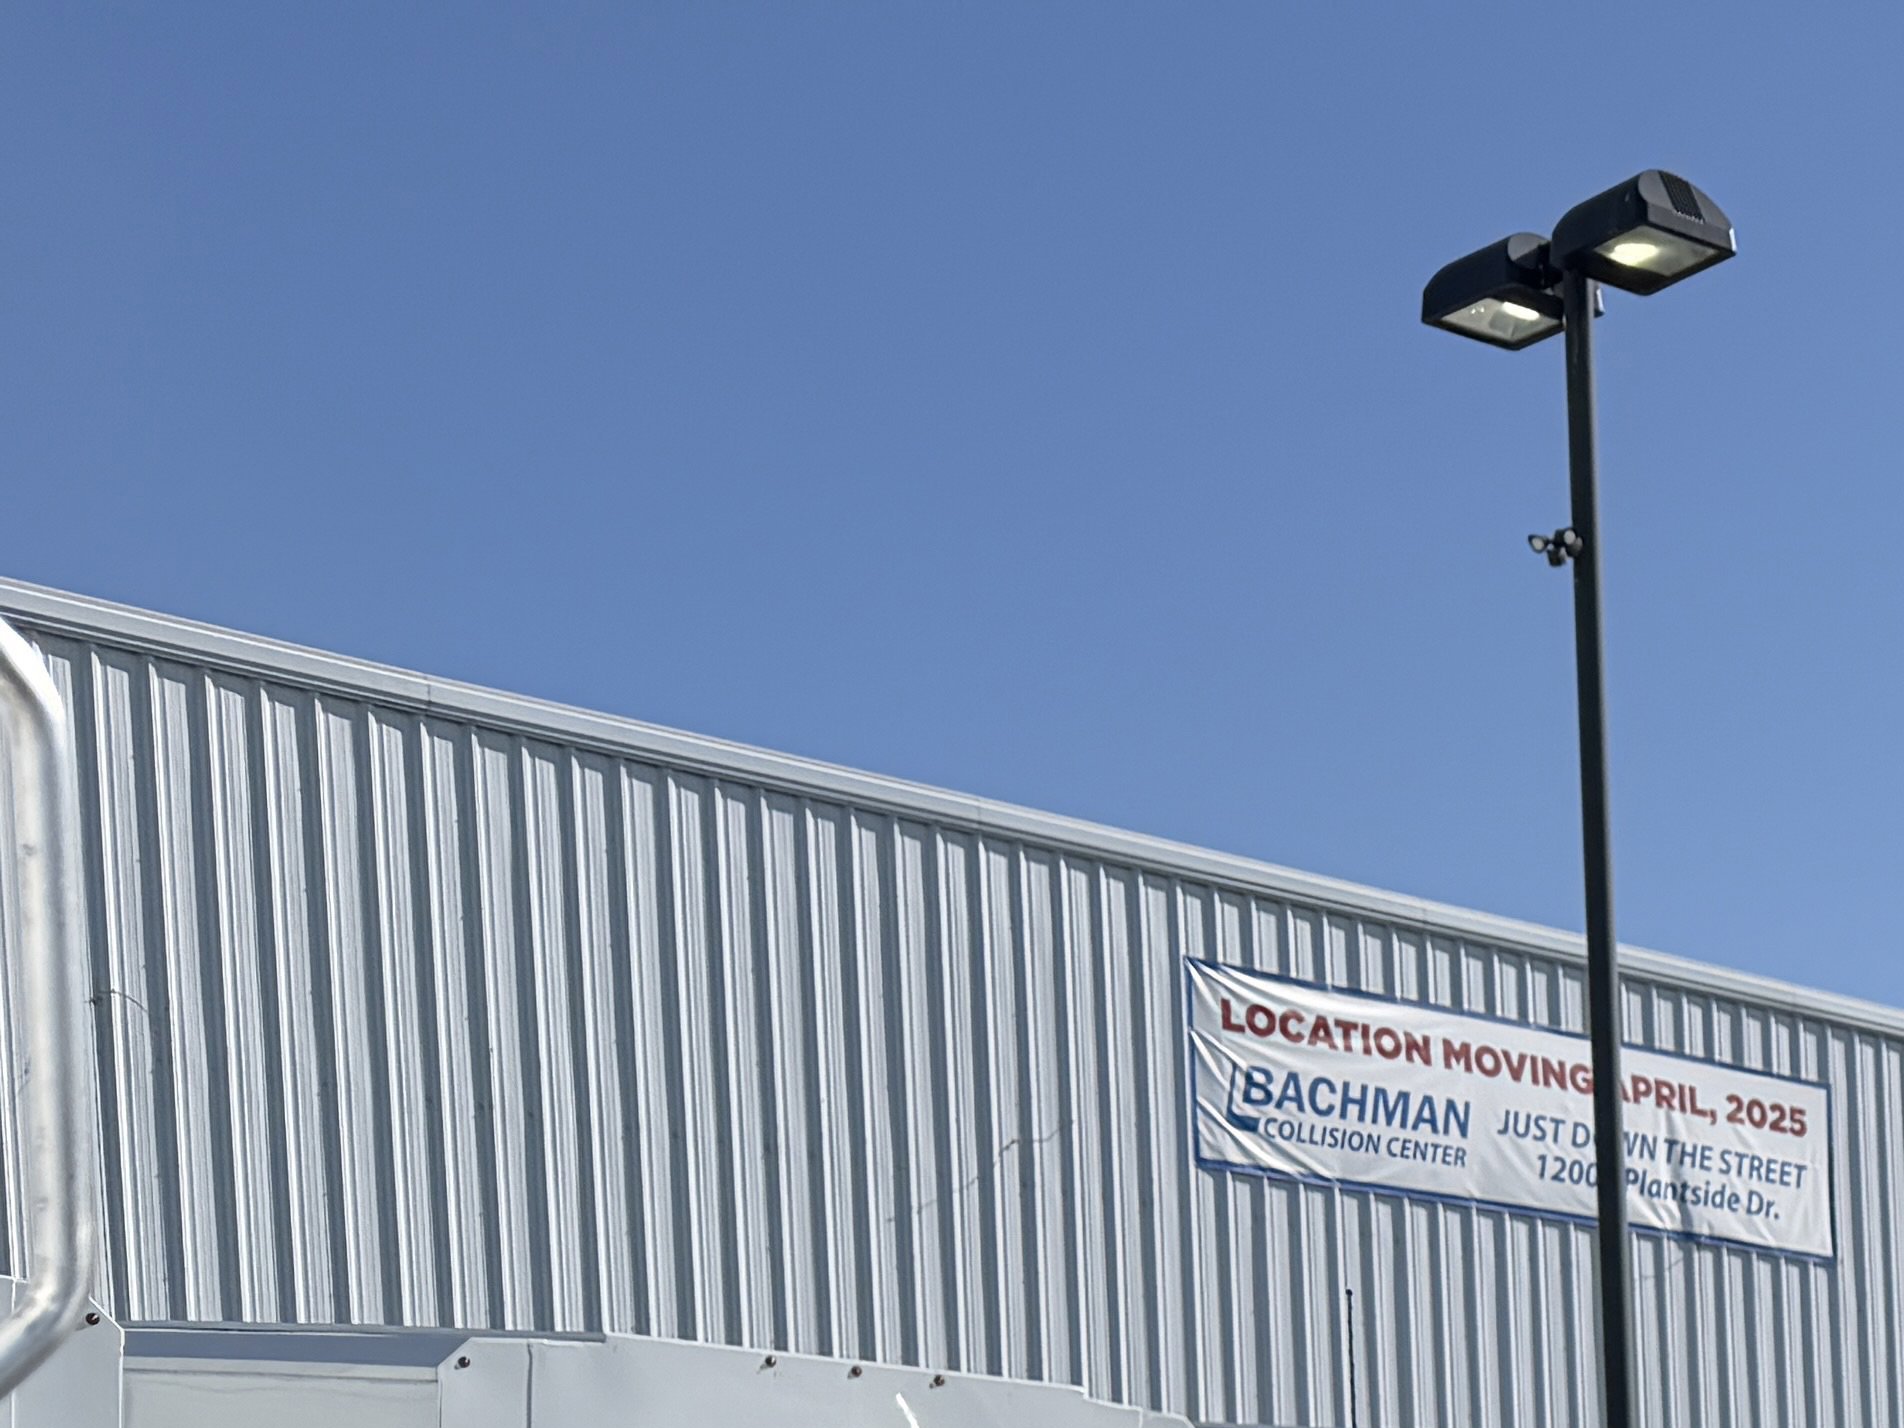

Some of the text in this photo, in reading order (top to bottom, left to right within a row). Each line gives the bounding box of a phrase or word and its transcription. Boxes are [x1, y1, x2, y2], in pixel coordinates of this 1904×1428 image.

[1220, 997, 1432, 1067] LOCATION
[1442, 1037, 1594, 1096] MOVING
[1725, 1093, 1808, 1138] 2025
[1241, 1065, 1472, 1140] BACHMAN
[1263, 1116, 1468, 1169] COLLISION CENTER
[1497, 1109, 1808, 1190] JUST DWN THE STREET
[1625, 1167, 1741, 1212] Plantside
[1746, 1190, 1781, 1222] Dr.
